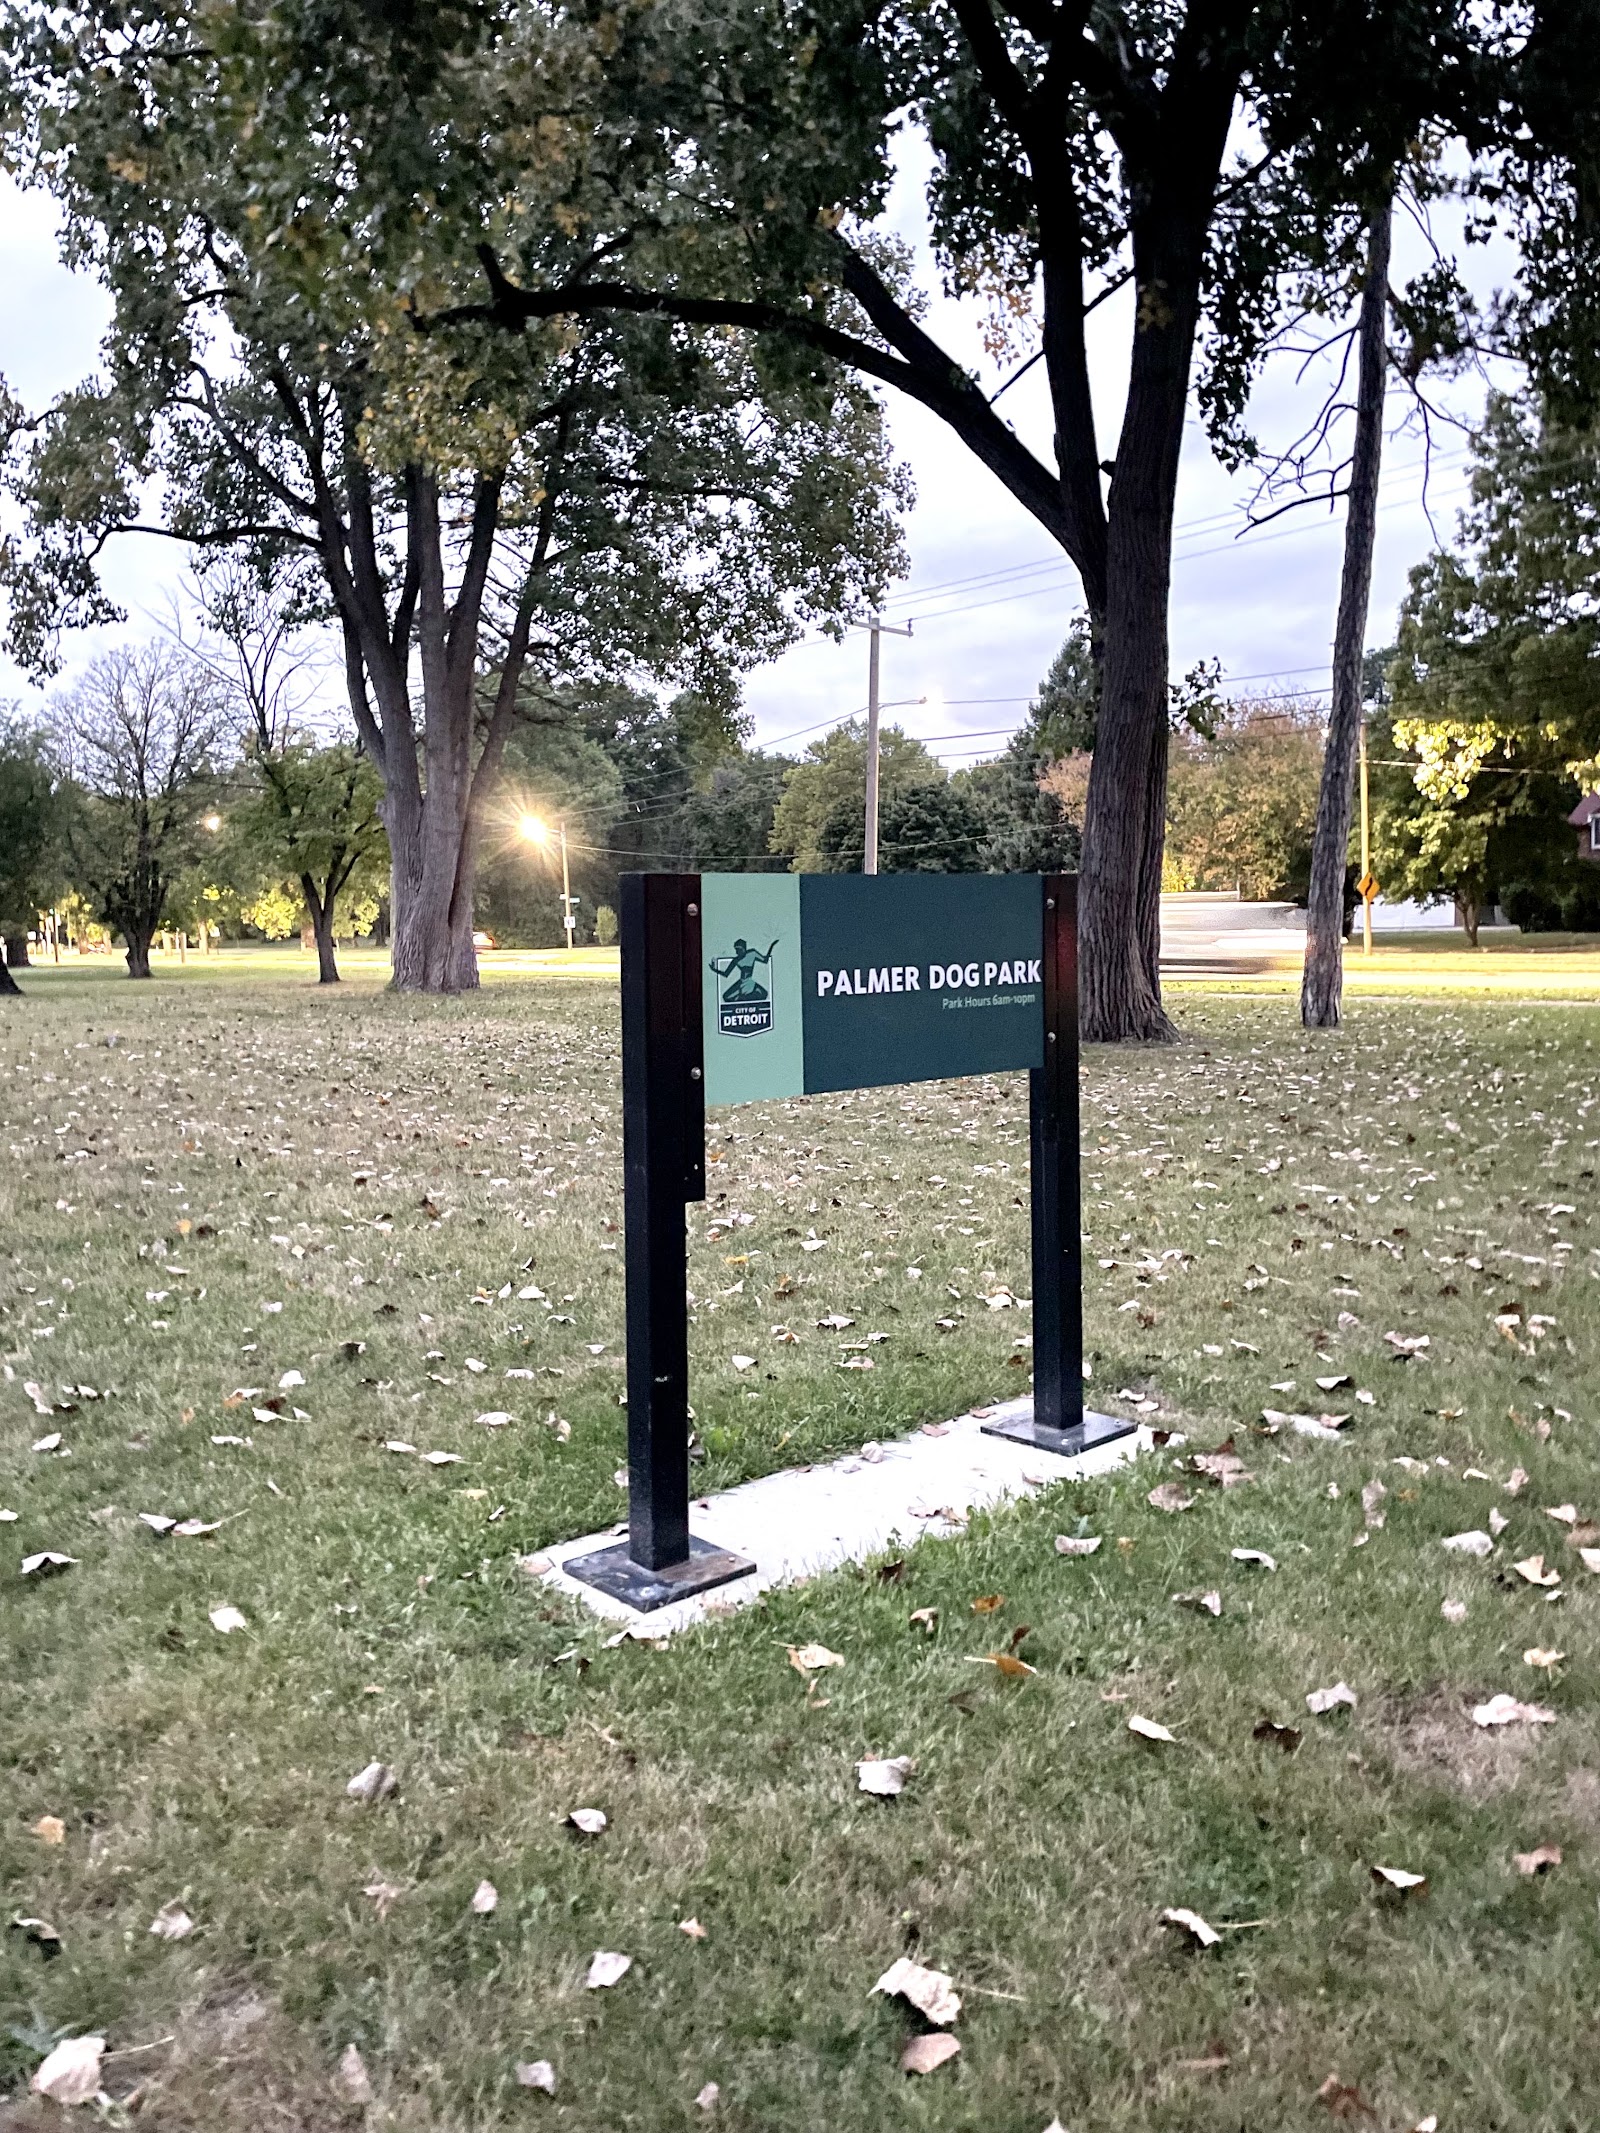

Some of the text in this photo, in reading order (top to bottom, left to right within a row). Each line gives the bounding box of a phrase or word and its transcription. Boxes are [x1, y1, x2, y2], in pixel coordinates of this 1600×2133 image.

[817, 960, 1041, 997] PALMER DOG PARK
[942, 994, 1035, 1010] Park Hours 6am-10pm
[724, 1014, 768, 1026] DETROIT
